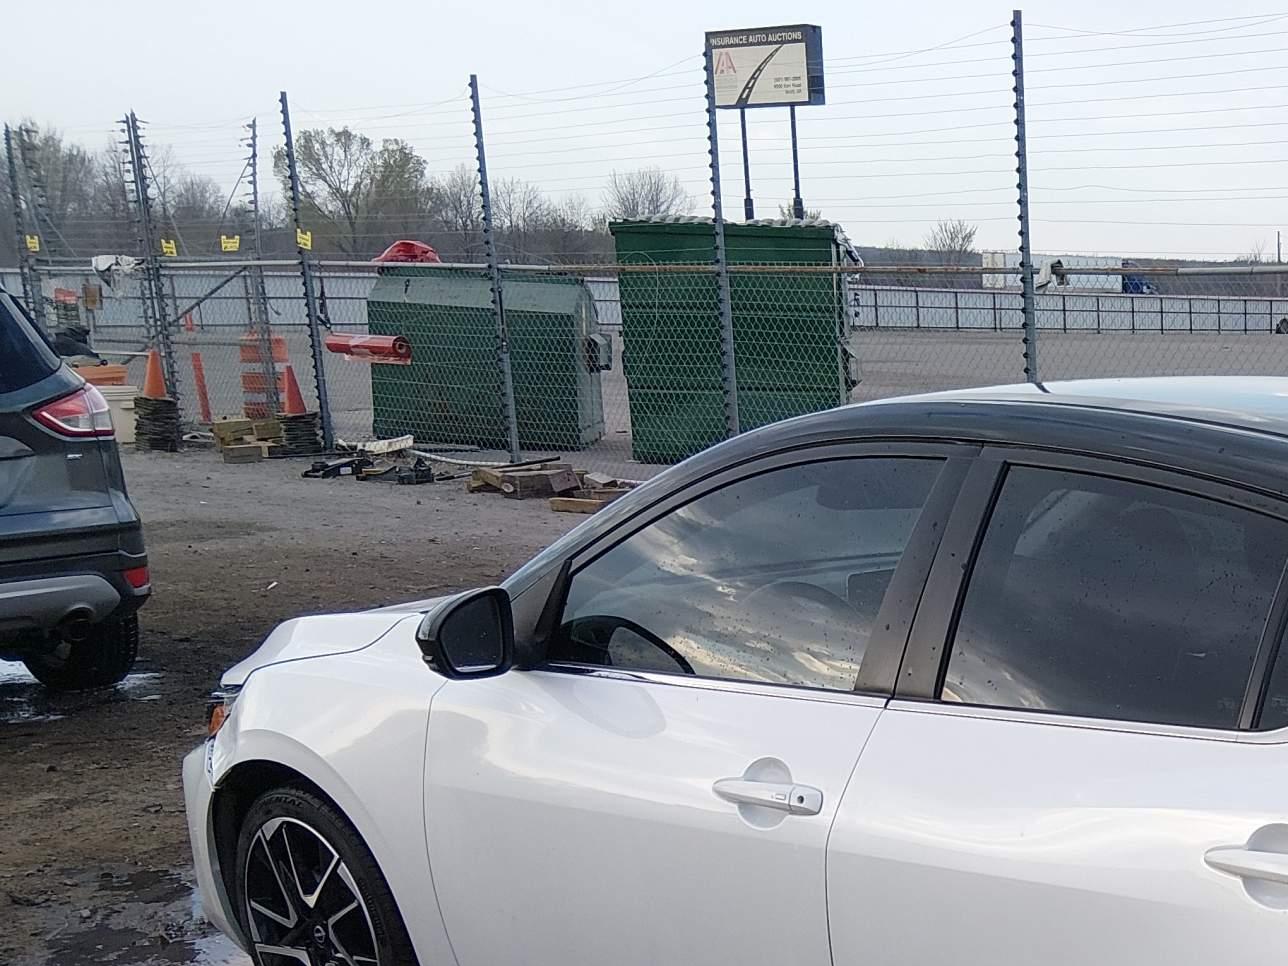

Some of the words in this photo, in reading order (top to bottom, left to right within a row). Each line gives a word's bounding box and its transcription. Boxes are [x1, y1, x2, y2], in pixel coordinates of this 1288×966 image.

[710, 35, 748, 46] INSURANCE
[749, 34, 767, 43] AUTO
[768, 32, 802, 42] AUCTIONS
